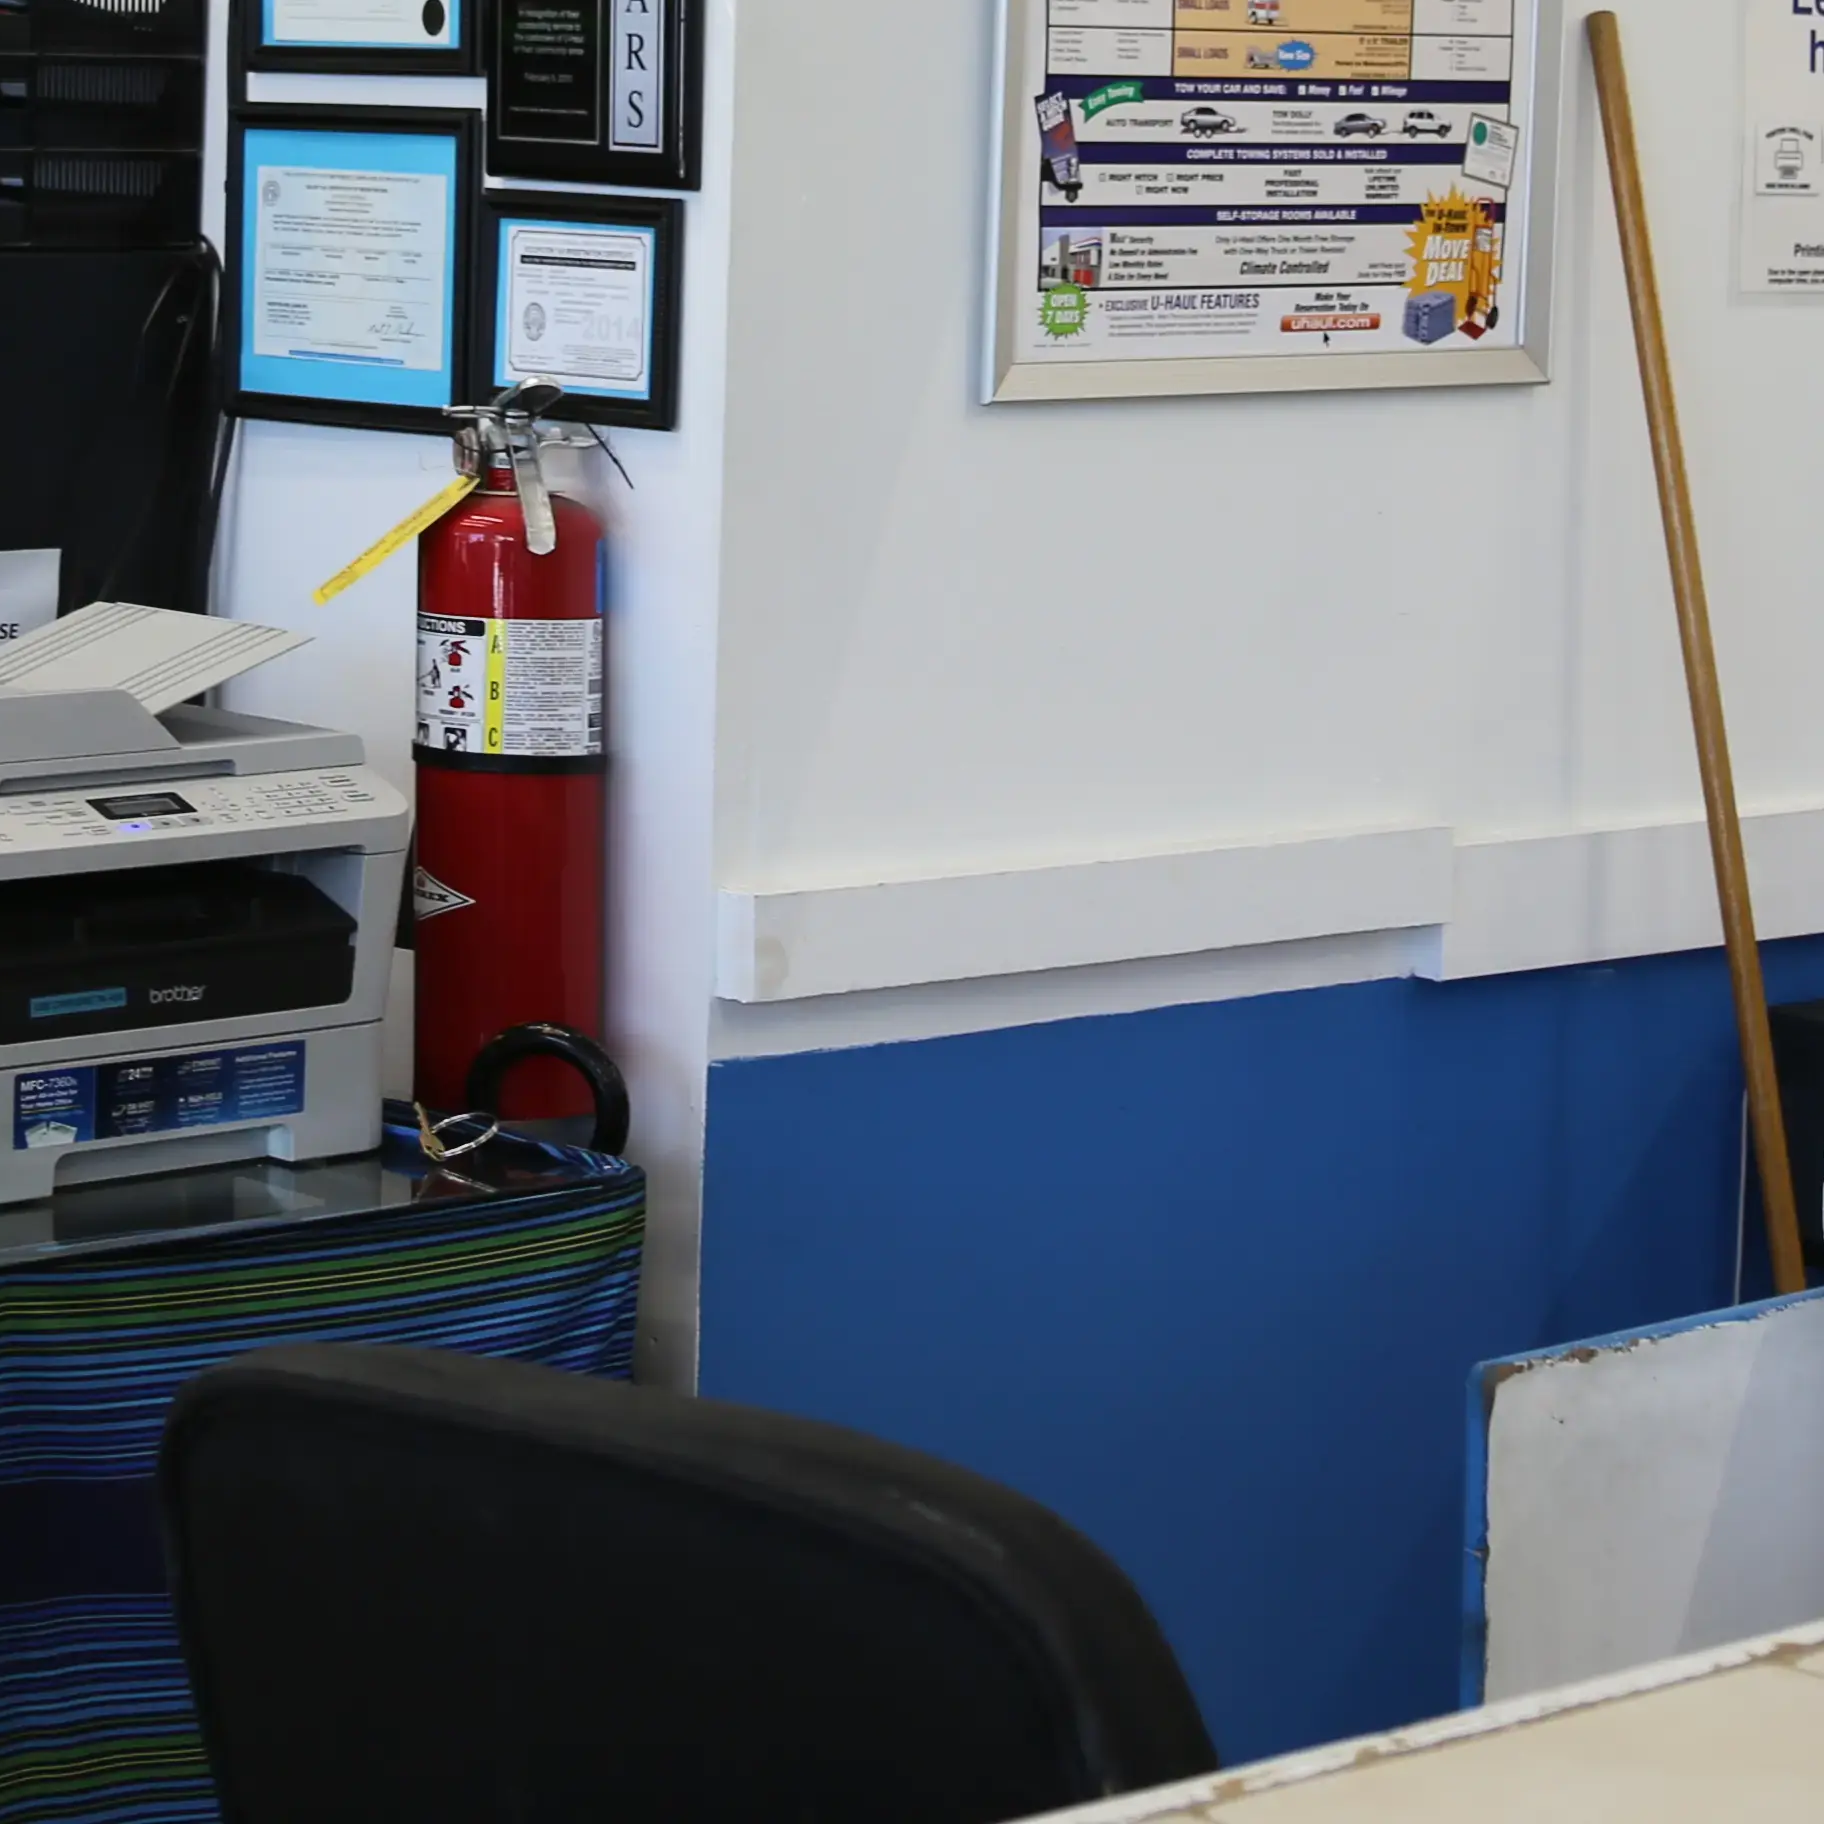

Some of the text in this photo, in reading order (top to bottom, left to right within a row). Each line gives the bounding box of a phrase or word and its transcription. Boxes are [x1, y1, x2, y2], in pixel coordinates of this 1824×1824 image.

[1200, 294, 1260, 309] FEATURES
[1291, 315, 1372, 331] uhaul.com
[490, 681, 499, 700] B
[489, 728, 498, 747] C
[149, 985, 206, 1004] brother
